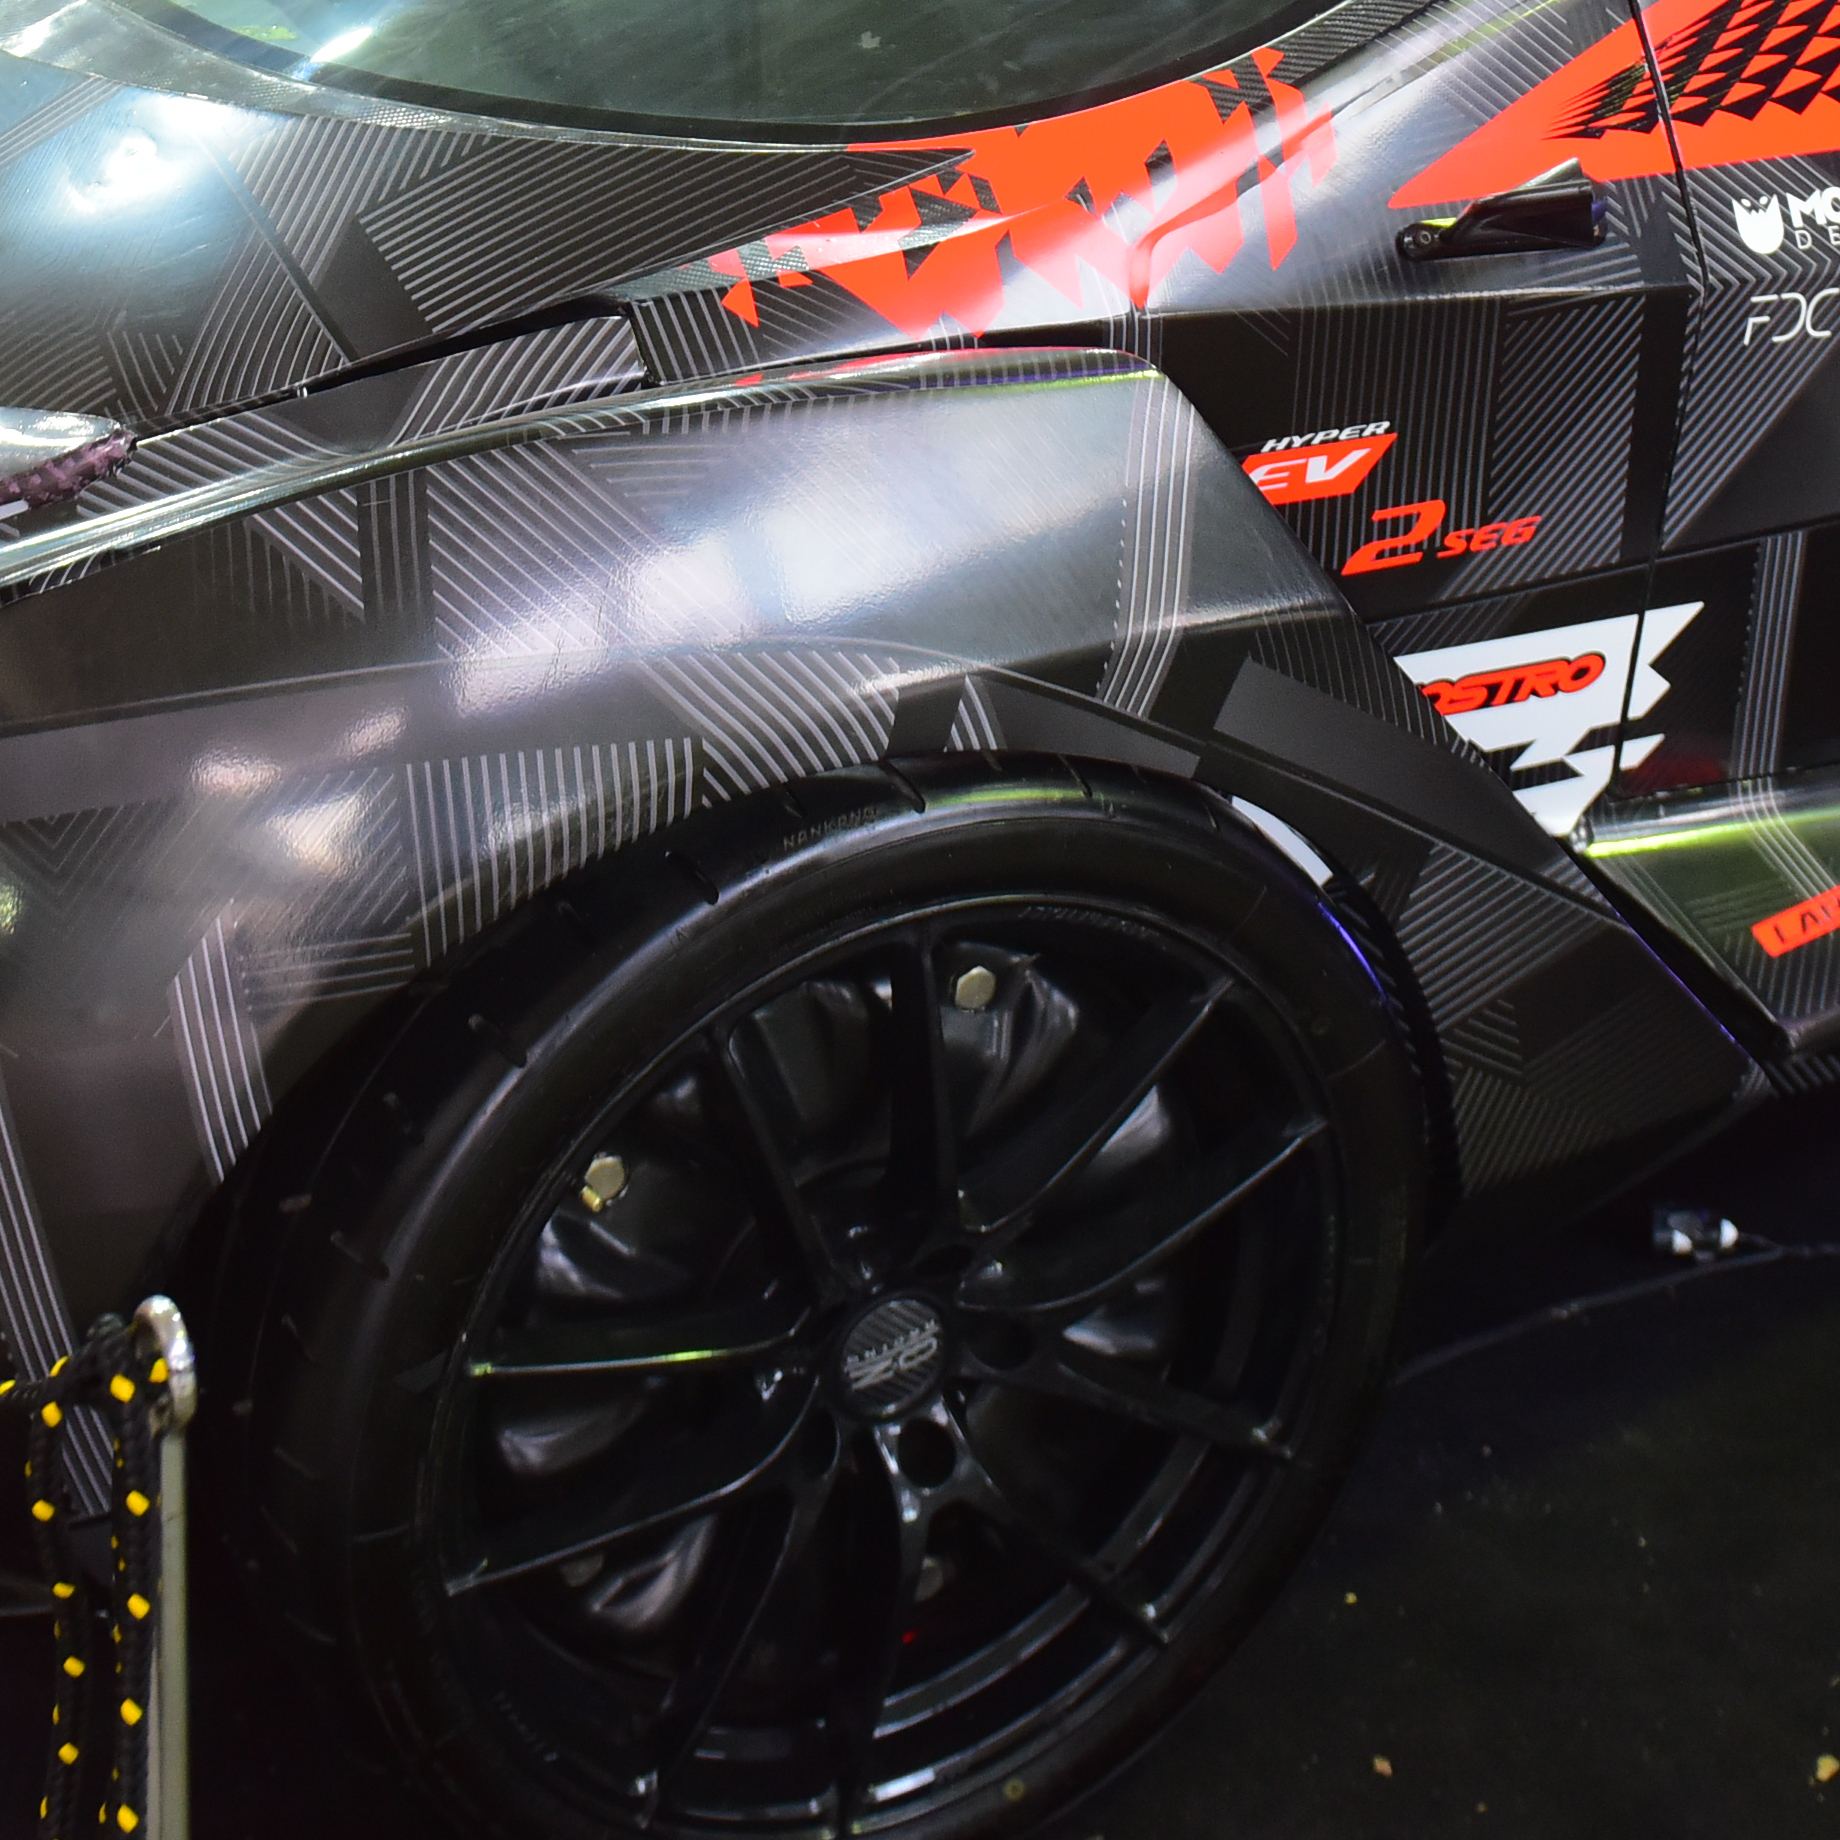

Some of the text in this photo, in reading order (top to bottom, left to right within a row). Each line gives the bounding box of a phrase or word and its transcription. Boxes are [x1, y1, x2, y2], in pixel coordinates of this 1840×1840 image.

[1743, 287, 1840, 346] FDC
[1260, 420, 1391, 454] HYPER
[1248, 447, 1373, 492] EV
[1340, 498, 1542, 577] 2 SEG
[1421, 651, 1607, 716] OSTRO
